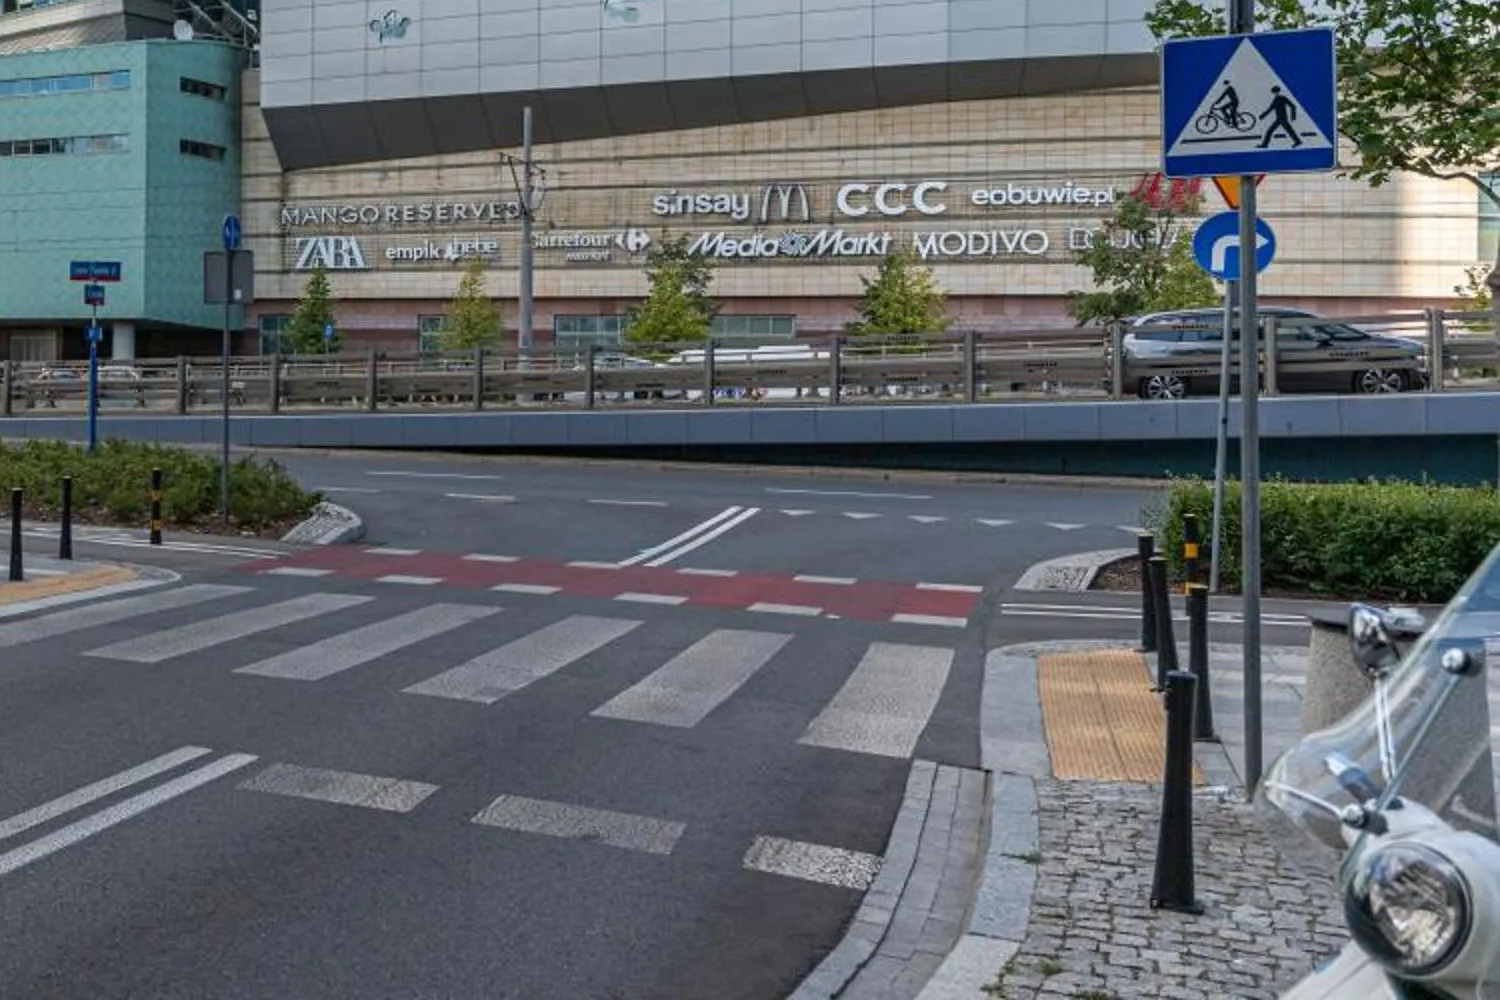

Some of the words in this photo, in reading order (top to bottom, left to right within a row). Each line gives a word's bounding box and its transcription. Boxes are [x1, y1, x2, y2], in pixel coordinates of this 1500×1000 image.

[652, 189, 749, 220] sinsay
[837, 181, 948, 217] CCC
[971, 180, 1115, 207] eobuwie.pl
[280, 204, 379, 226] MANGO
[385, 200, 521, 223] RESERVED
[296, 235, 366, 269] ZARA
[385, 238, 440, 262] empik
[687, 230, 781, 258] Media
[801, 228, 893, 257] Markt
[913, 229, 1050, 260] MODIVO
